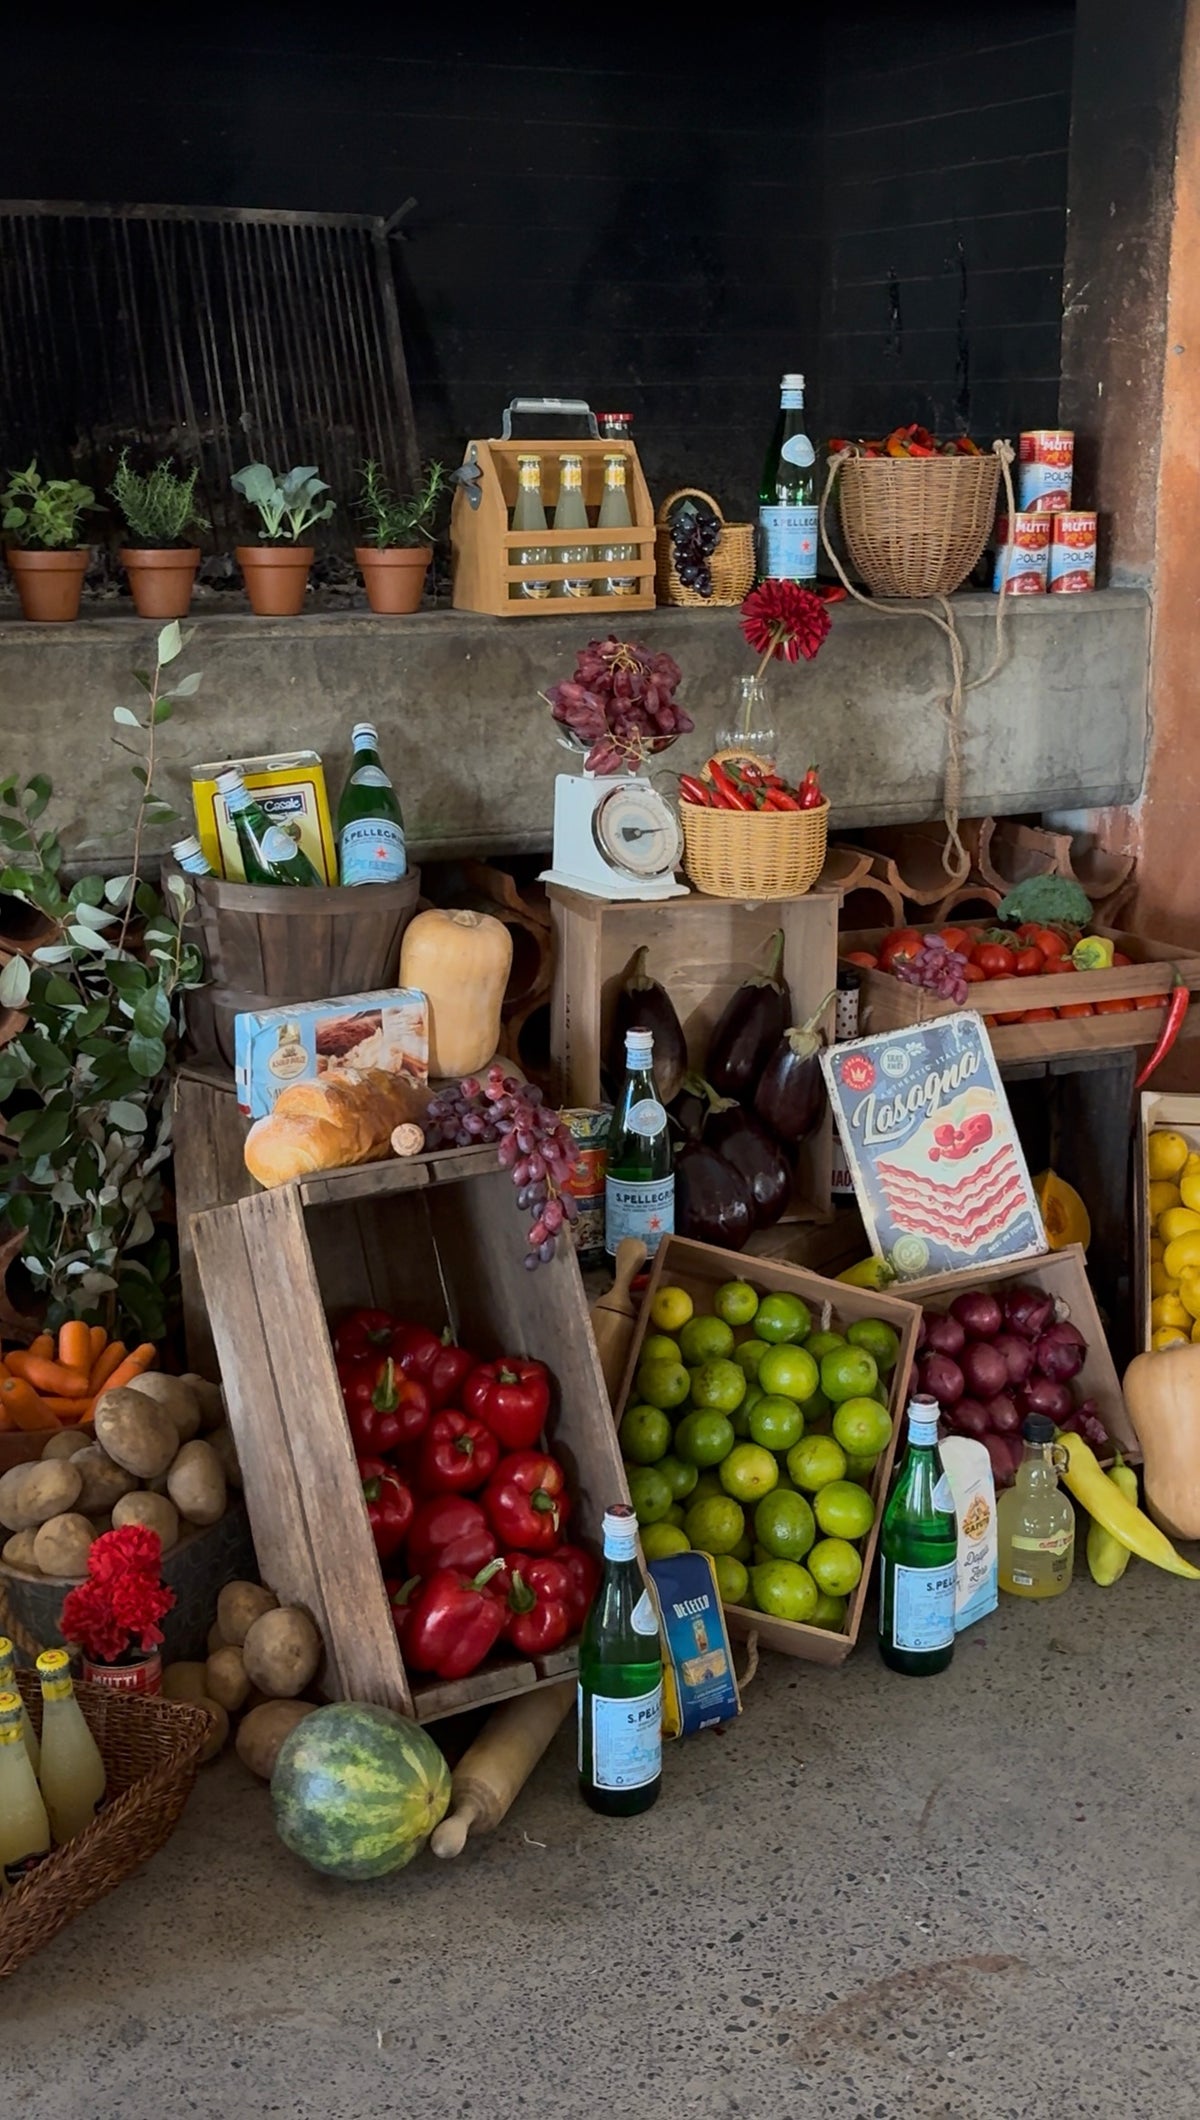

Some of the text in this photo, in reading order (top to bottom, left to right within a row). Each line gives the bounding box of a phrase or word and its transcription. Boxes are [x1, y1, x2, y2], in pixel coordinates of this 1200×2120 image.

[851, 1051, 981, 1146] Lasagna
[880, 1041, 975, 1100] AUTHENTIC ITALIAN
[92, 1672, 138, 1687] MUTTI
